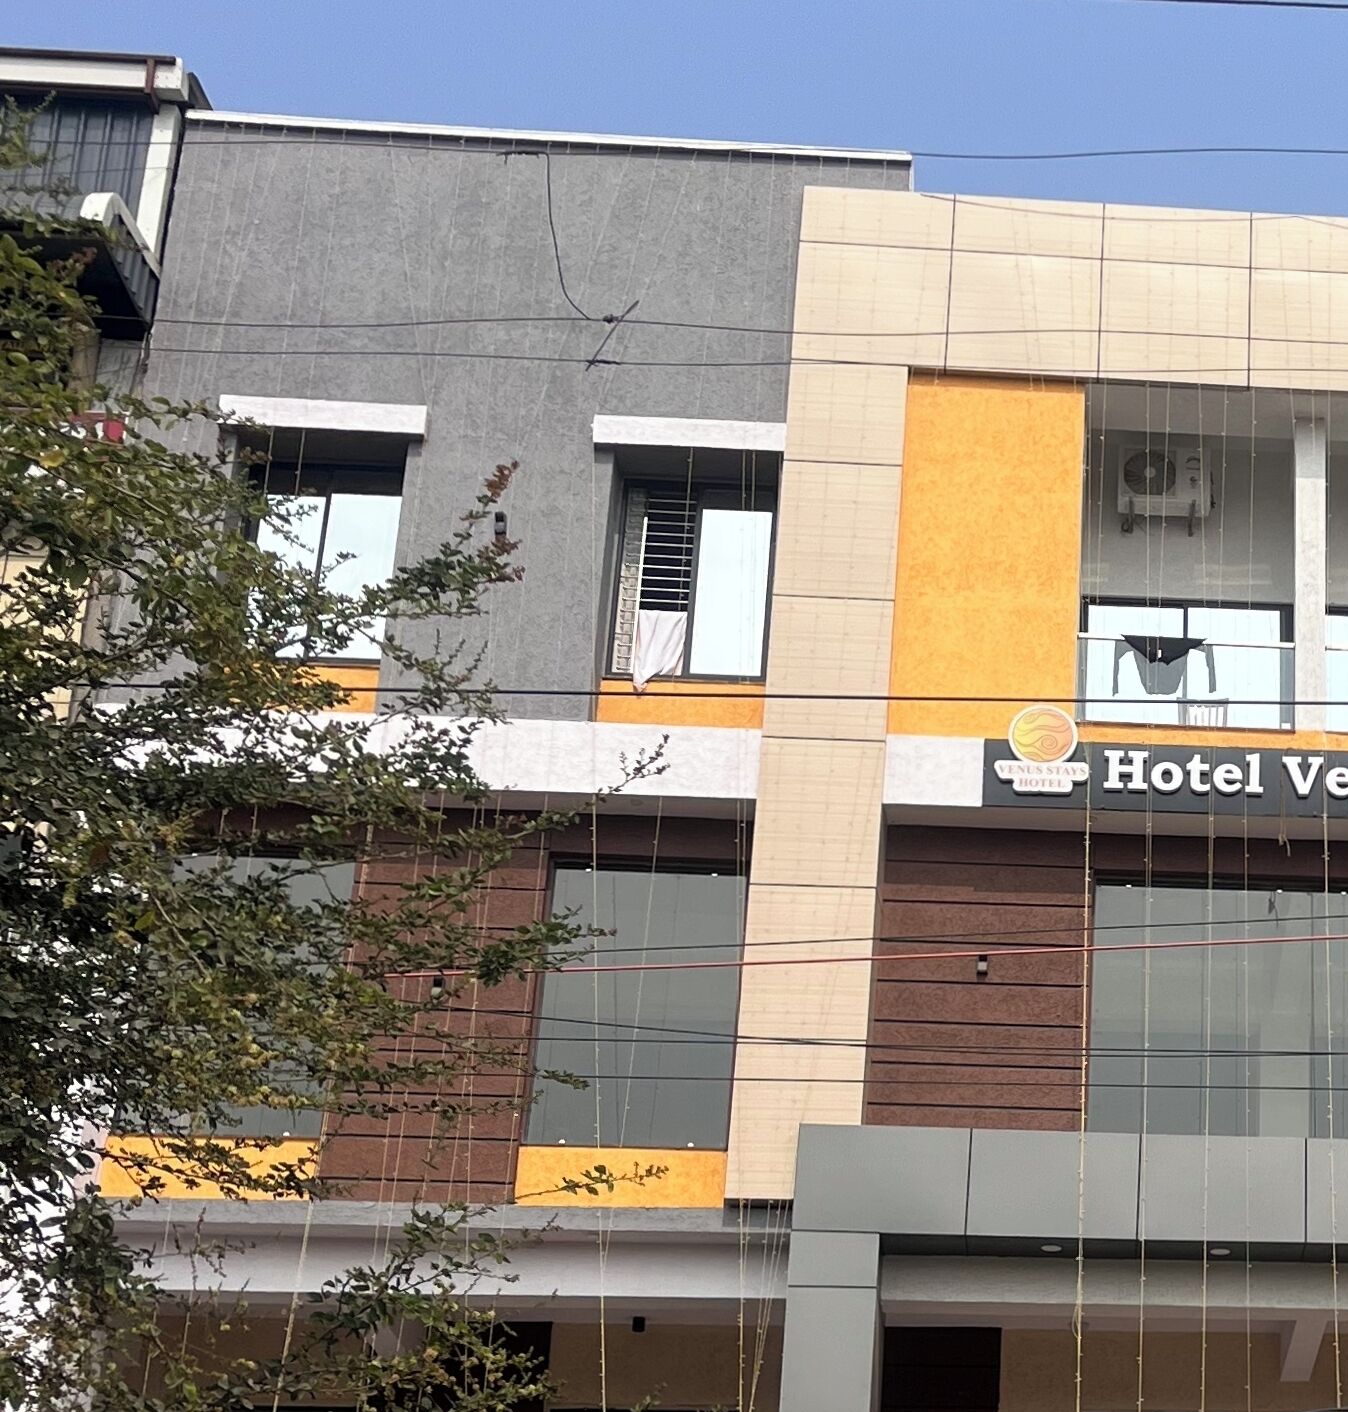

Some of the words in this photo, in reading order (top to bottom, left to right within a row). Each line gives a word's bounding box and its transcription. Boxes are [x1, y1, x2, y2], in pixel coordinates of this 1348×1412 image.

[999, 764, 1043, 775] VENUS
[1046, 765, 1087, 776] STAYS
[1103, 749, 1264, 796] Hotel
[1018, 778, 1066, 788] HOTEL
